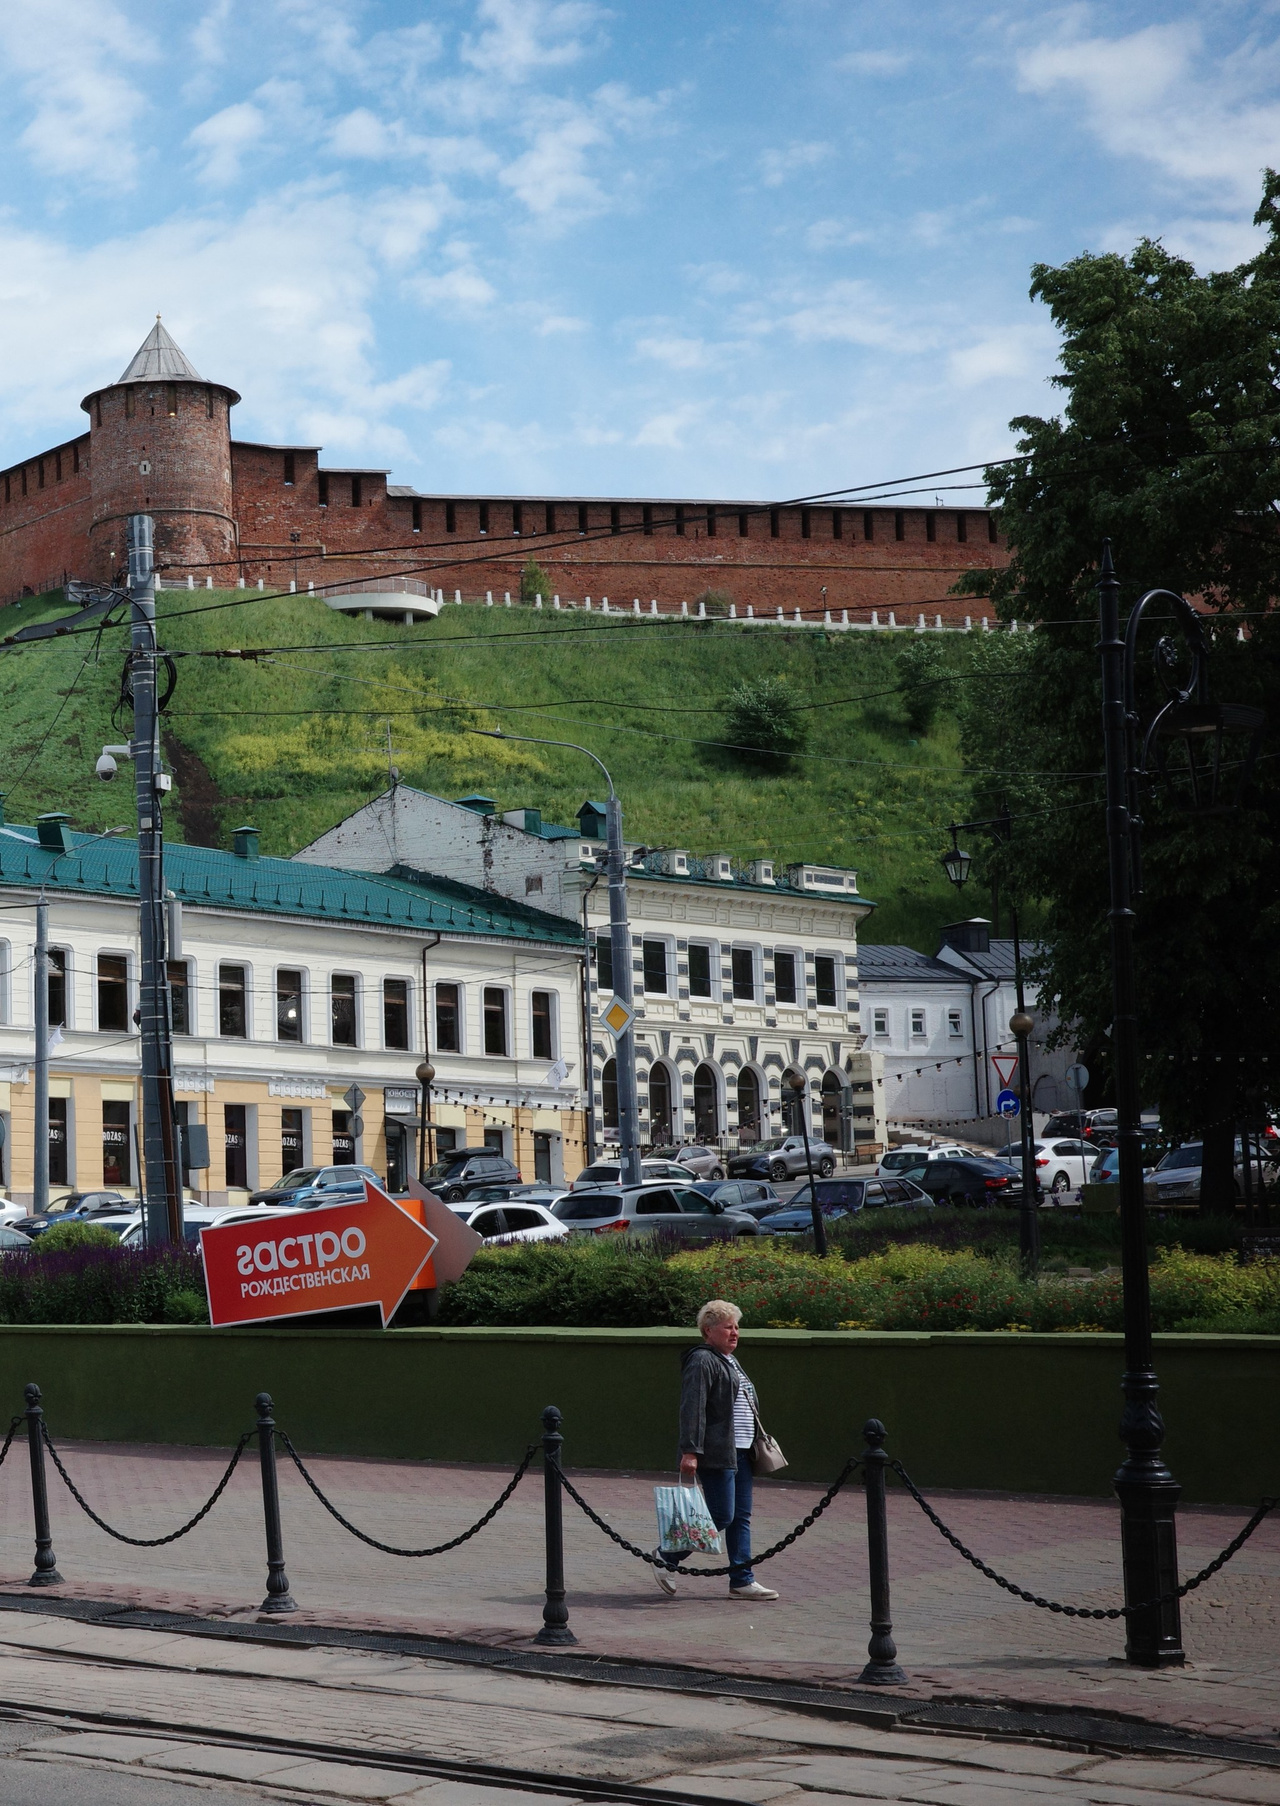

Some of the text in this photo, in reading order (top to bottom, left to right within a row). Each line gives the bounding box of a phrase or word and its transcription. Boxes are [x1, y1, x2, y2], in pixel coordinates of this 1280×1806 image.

[224, 1134, 239, 1144] OZAS
[282, 1136, 297, 1147] OZAS
[236, 1226, 367, 1276] гастро
[240, 1263, 371, 1298] РОЖДЕСТВЕНСКАЯ
